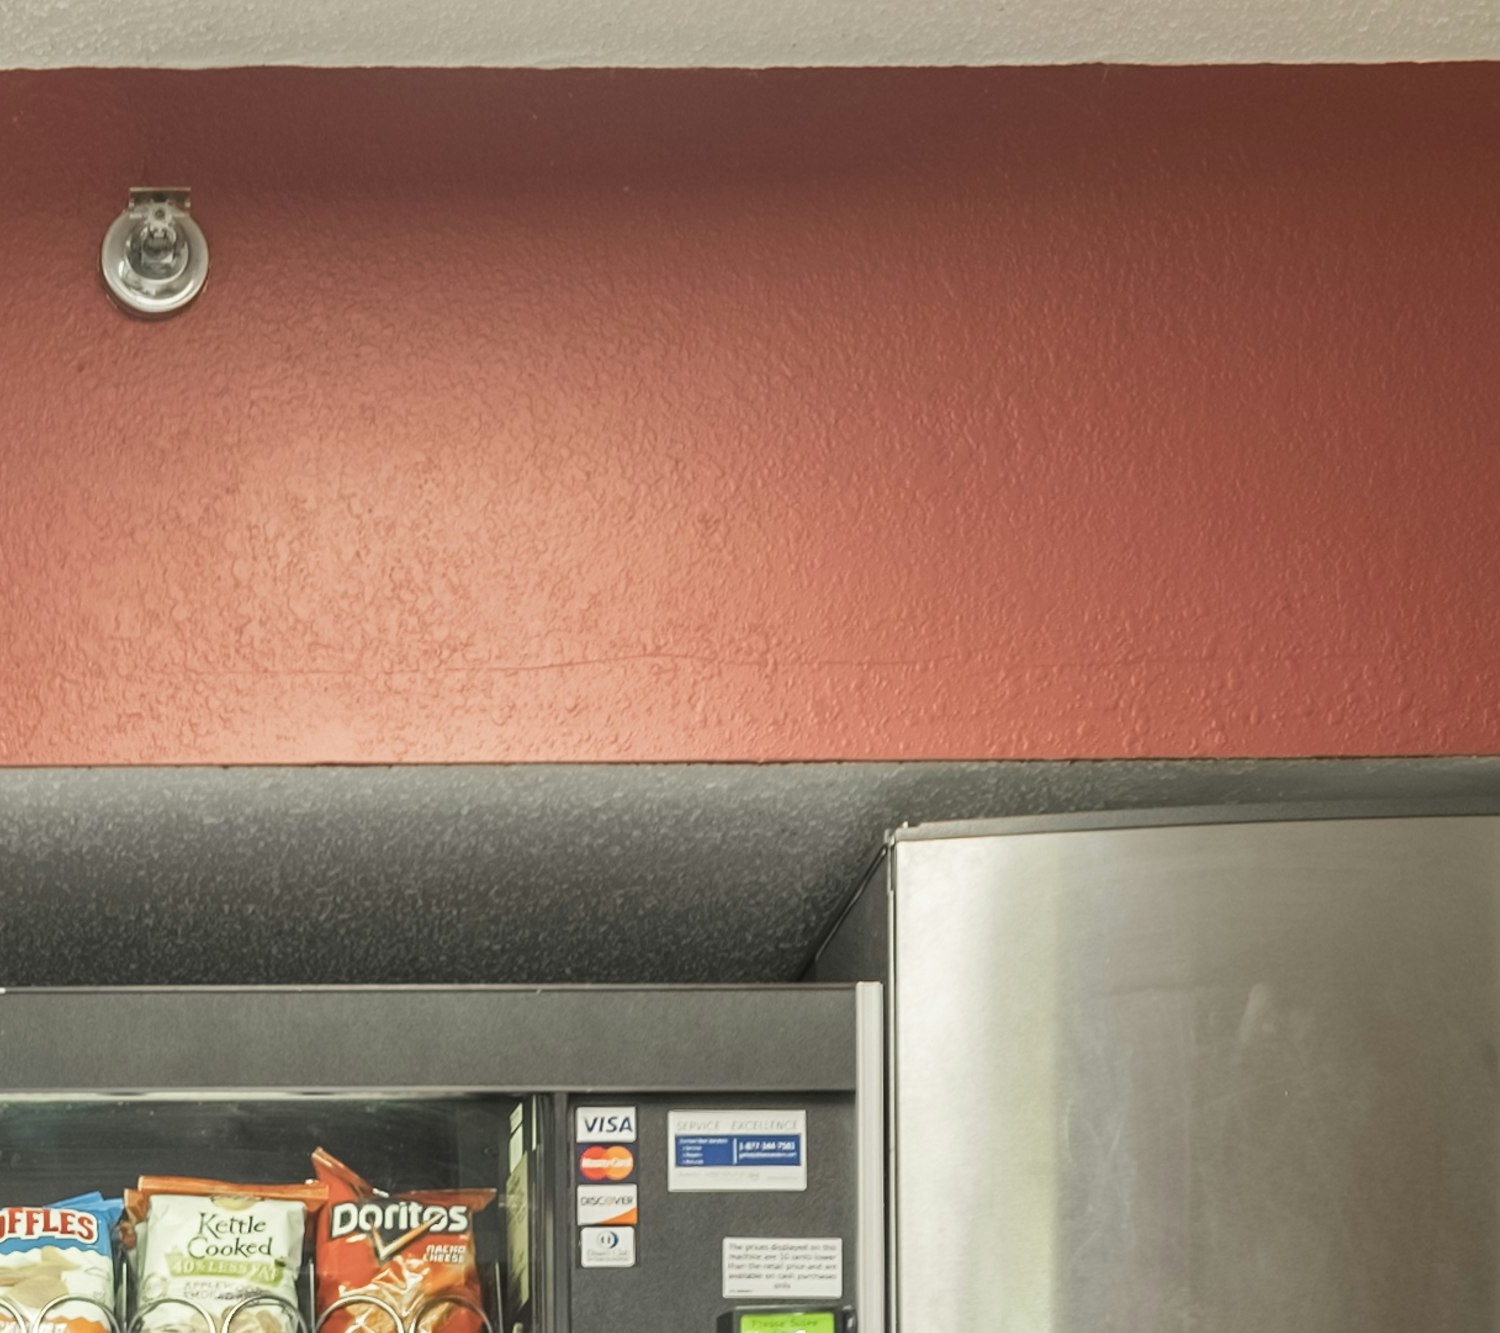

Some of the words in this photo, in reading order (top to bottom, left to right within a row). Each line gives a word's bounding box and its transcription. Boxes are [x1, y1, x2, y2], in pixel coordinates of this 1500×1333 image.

[584, 1116, 633, 1133] VISA
[677, 1120, 720, 1131] SERVICE
[580, 1196, 634, 1206] DISCOVER
[199, 1211, 267, 1239] Kettle
[331, 1202, 469, 1239] Doritos
[187, 1235, 273, 1260] Cooked
